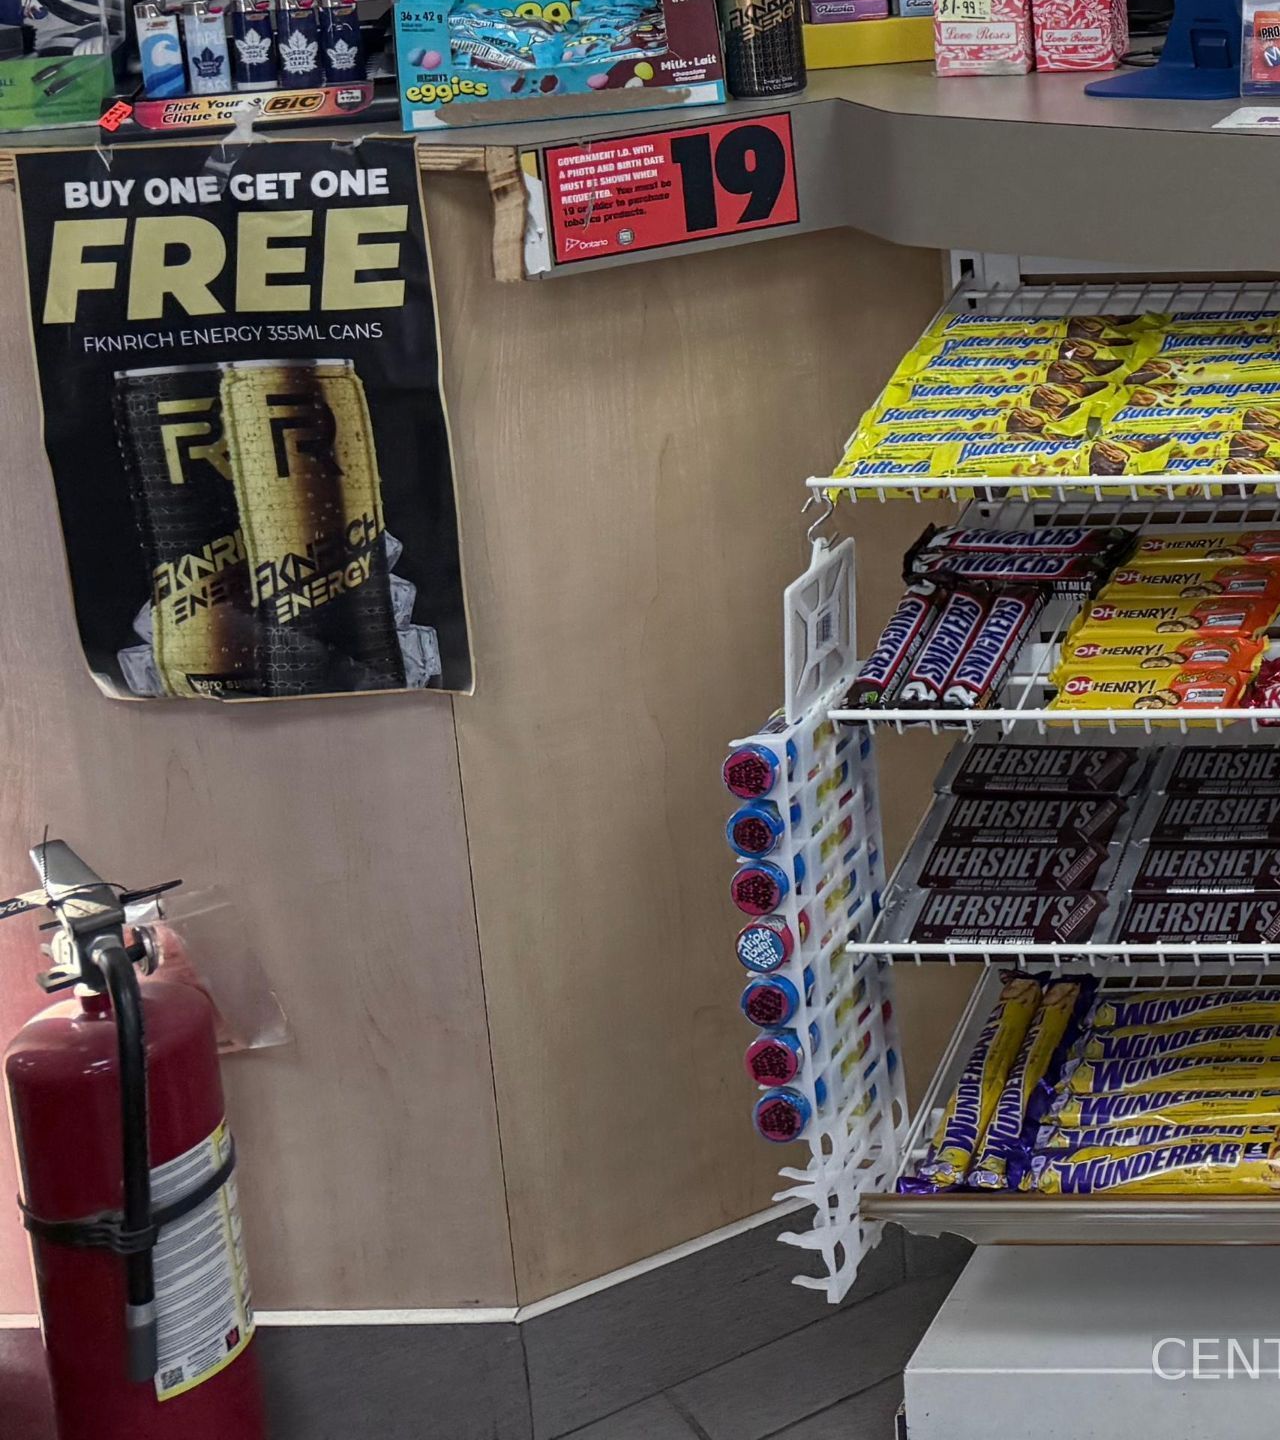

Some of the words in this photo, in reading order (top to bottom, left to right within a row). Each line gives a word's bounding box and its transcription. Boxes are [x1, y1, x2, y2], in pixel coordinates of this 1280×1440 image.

[64, 180, 136, 208] BUY
[144, 176, 221, 203] ONE
[230, 172, 301, 201] GET
[310, 168, 389, 198] ONE
[670, 124, 786, 232] 19
[42, 205, 409, 324] FREE
[83, 333, 173, 353] FKNRICH
[181, 326, 263, 348] ENERGY
[266, 325, 325, 343] 355ML
[329, 323, 383, 341] CANS
[961, 438, 1084, 465] Butterfinger
[1067, 679, 1093, 694] OH
[1093, 679, 1156, 696] HENRY!
[1060, 1142, 1238, 1188] WUNDERBAR
